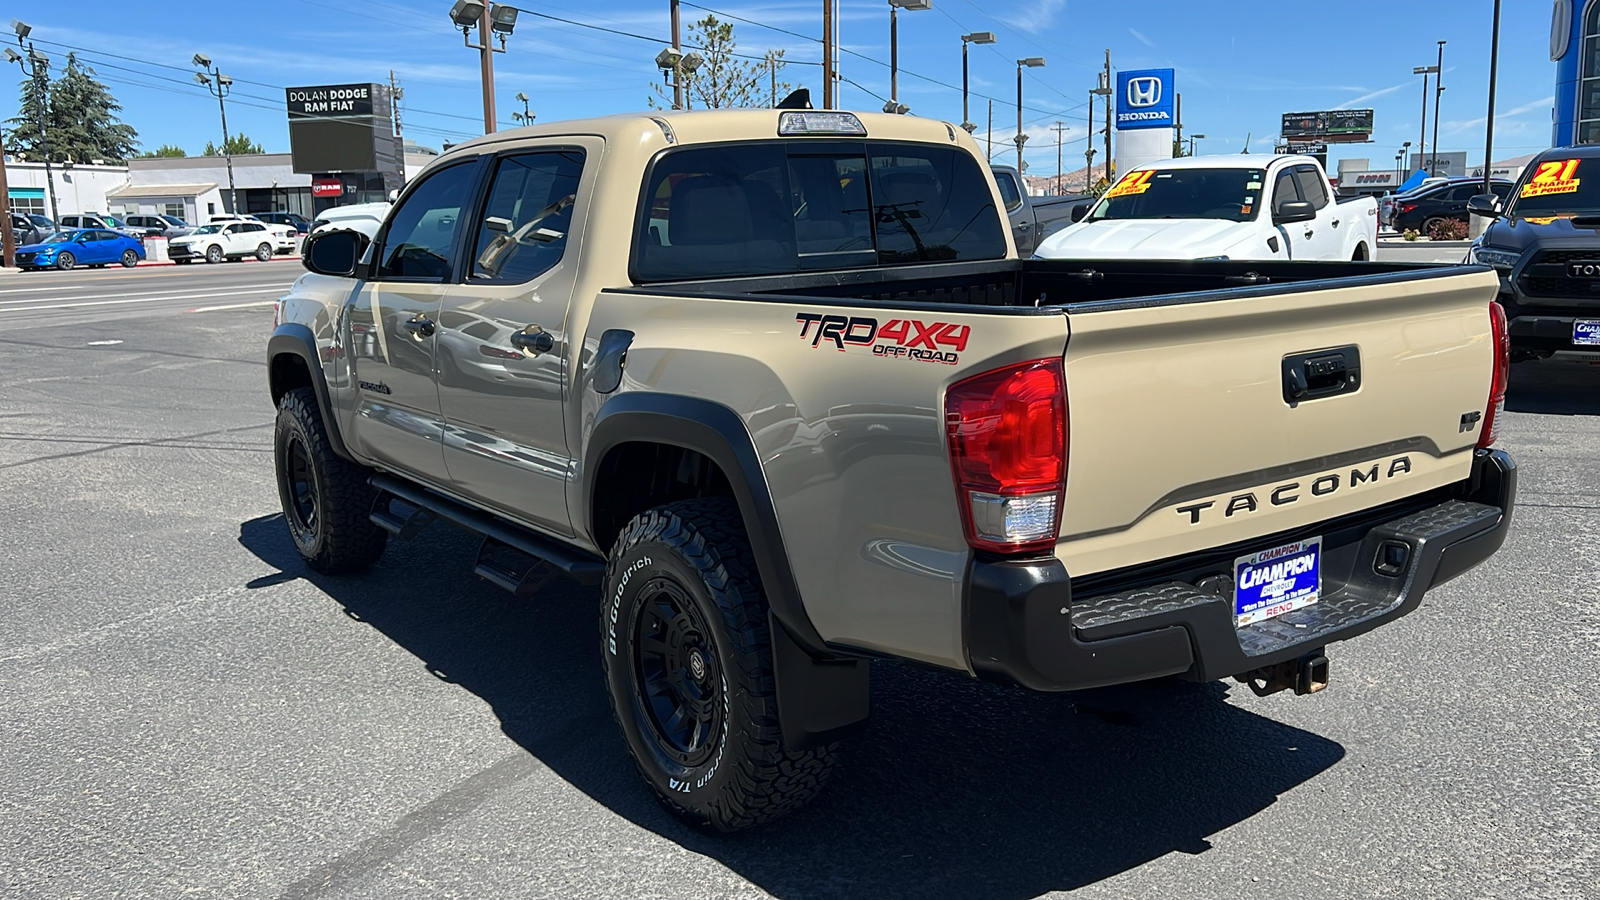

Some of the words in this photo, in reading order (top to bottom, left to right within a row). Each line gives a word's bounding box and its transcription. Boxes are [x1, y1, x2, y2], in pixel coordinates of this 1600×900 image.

[290, 91, 327, 102] DOLAN
[330, 88, 368, 100] DODGE
[304, 102, 328, 112] RAM
[331, 101, 354, 111] FIAT
[1118, 111, 1170, 121] HONDA
[1121, 170, 1154, 186] 21
[1533, 160, 1578, 182] 21
[347, 185, 357, 193] 757
[1530, 180, 1575, 189] SHARP
[796, 312, 879, 352] TRD
[877, 319, 971, 352] 4X4
[872, 344, 907, 359] OFF
[908, 349, 960, 366] ROAD
[358, 380, 389, 395] TACOMA
[1176, 456, 1412, 525] TACOMA
[1259, 543, 1300, 562] CHAMPION
[1239, 553, 1316, 590] CHAMPION
[1263, 580, 1294, 595] CHEVROLET
[609, 555, 652, 656] BFGoodrich
[1266, 602, 1293, 617] RENO
[669, 778, 690, 793] T/A
